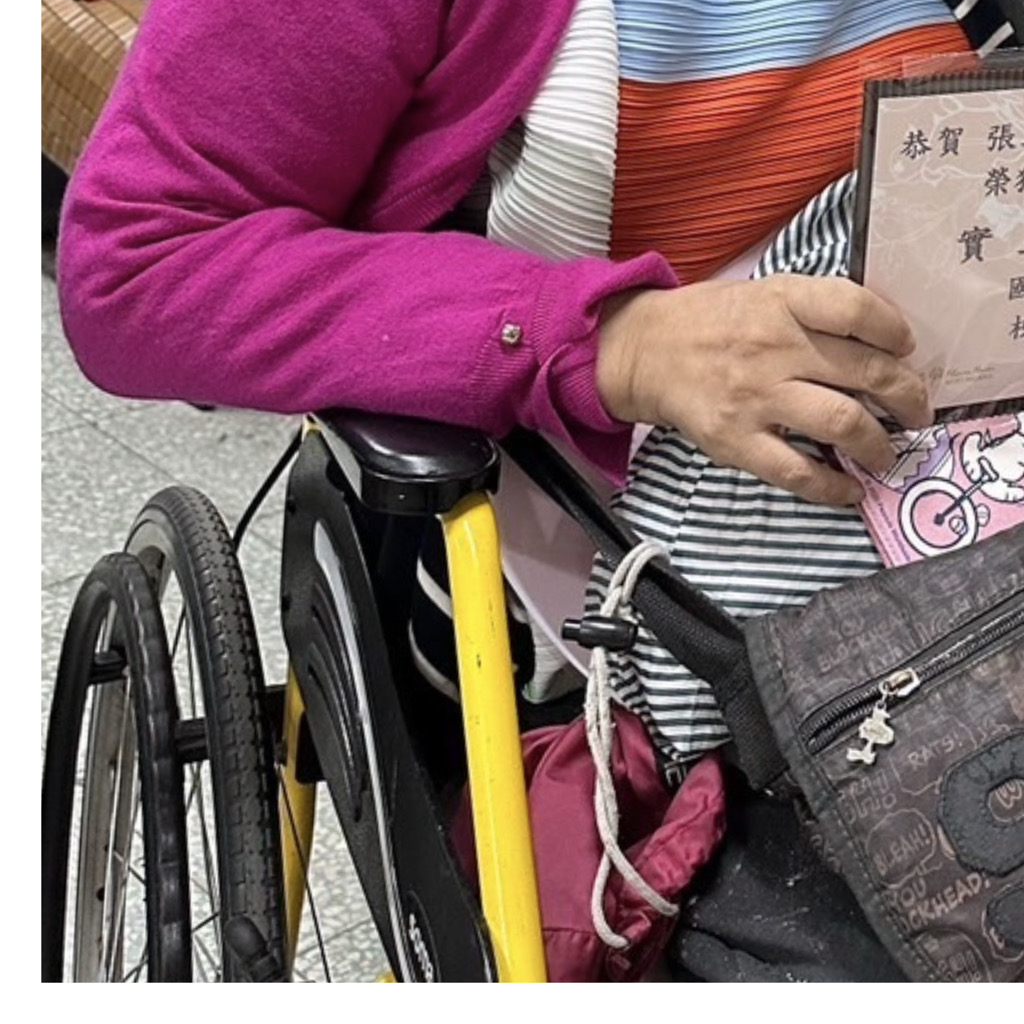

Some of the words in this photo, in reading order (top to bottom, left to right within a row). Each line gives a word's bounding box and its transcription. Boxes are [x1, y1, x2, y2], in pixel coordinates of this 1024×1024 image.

[900, 126, 965, 160] 恭賀
[907, 732, 964, 772] RATS!
[872, 825, 931, 876] BLEAH!
